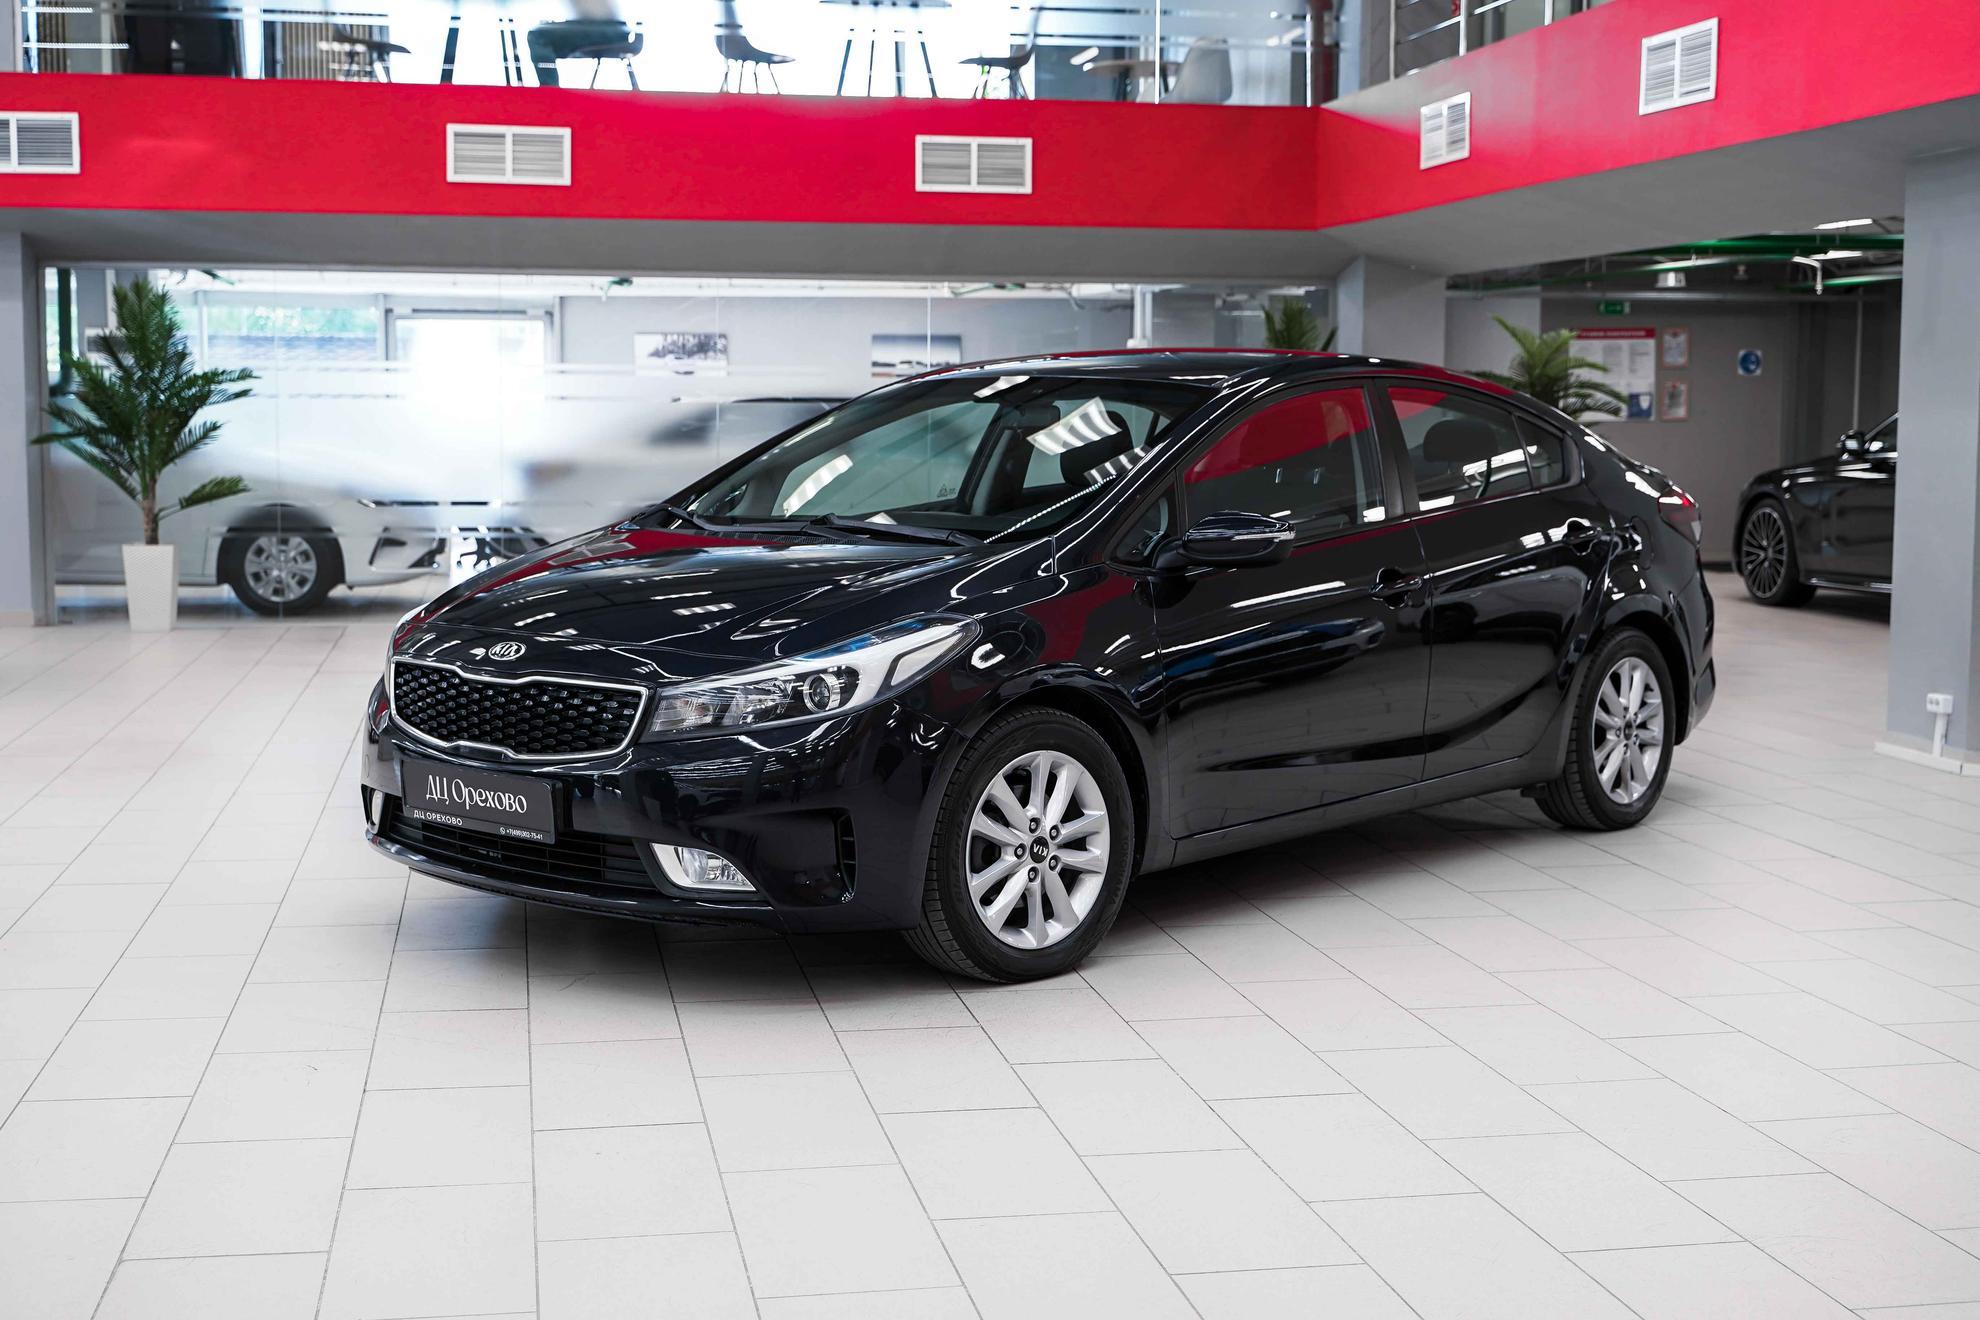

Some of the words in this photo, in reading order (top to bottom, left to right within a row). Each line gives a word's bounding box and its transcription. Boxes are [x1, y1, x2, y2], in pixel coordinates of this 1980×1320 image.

[426, 774, 450, 805] ДЦ
[451, 778, 528, 814] Орехово
[413, 809, 425, 820] ДЦ
[426, 811, 463, 826] ОРЕХОВО
[1033, 843, 1049, 857] KIA
